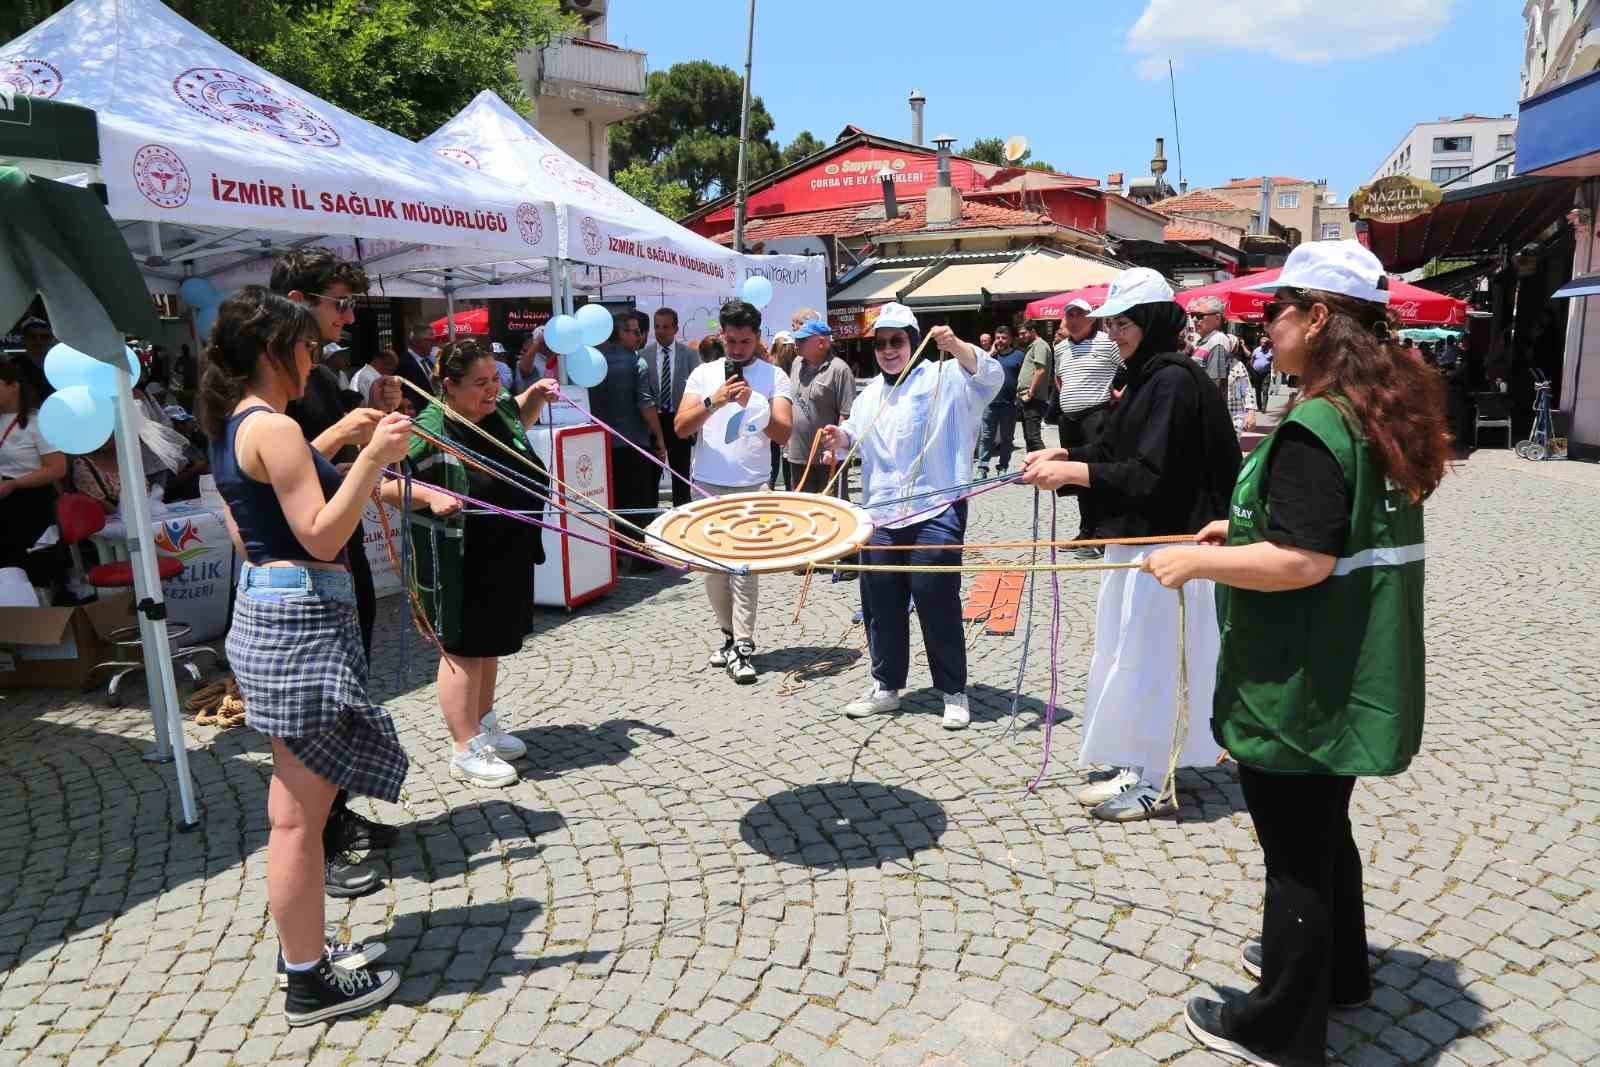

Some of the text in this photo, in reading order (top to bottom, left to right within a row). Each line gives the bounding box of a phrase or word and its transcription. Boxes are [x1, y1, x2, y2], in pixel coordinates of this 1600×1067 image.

[211, 173, 287, 208] İZMİR
[291, 183, 315, 211] İL
[319, 190, 398, 219] SAĞLIK
[401, 201, 508, 233] MÜDÜRLÜĞÜ
[842, 175, 854, 187] VE
[856, 175, 868, 185] EV
[608, 234, 724, 279] İZMİR İL SAĞLIK MÜDÜRLÜĞÜ
